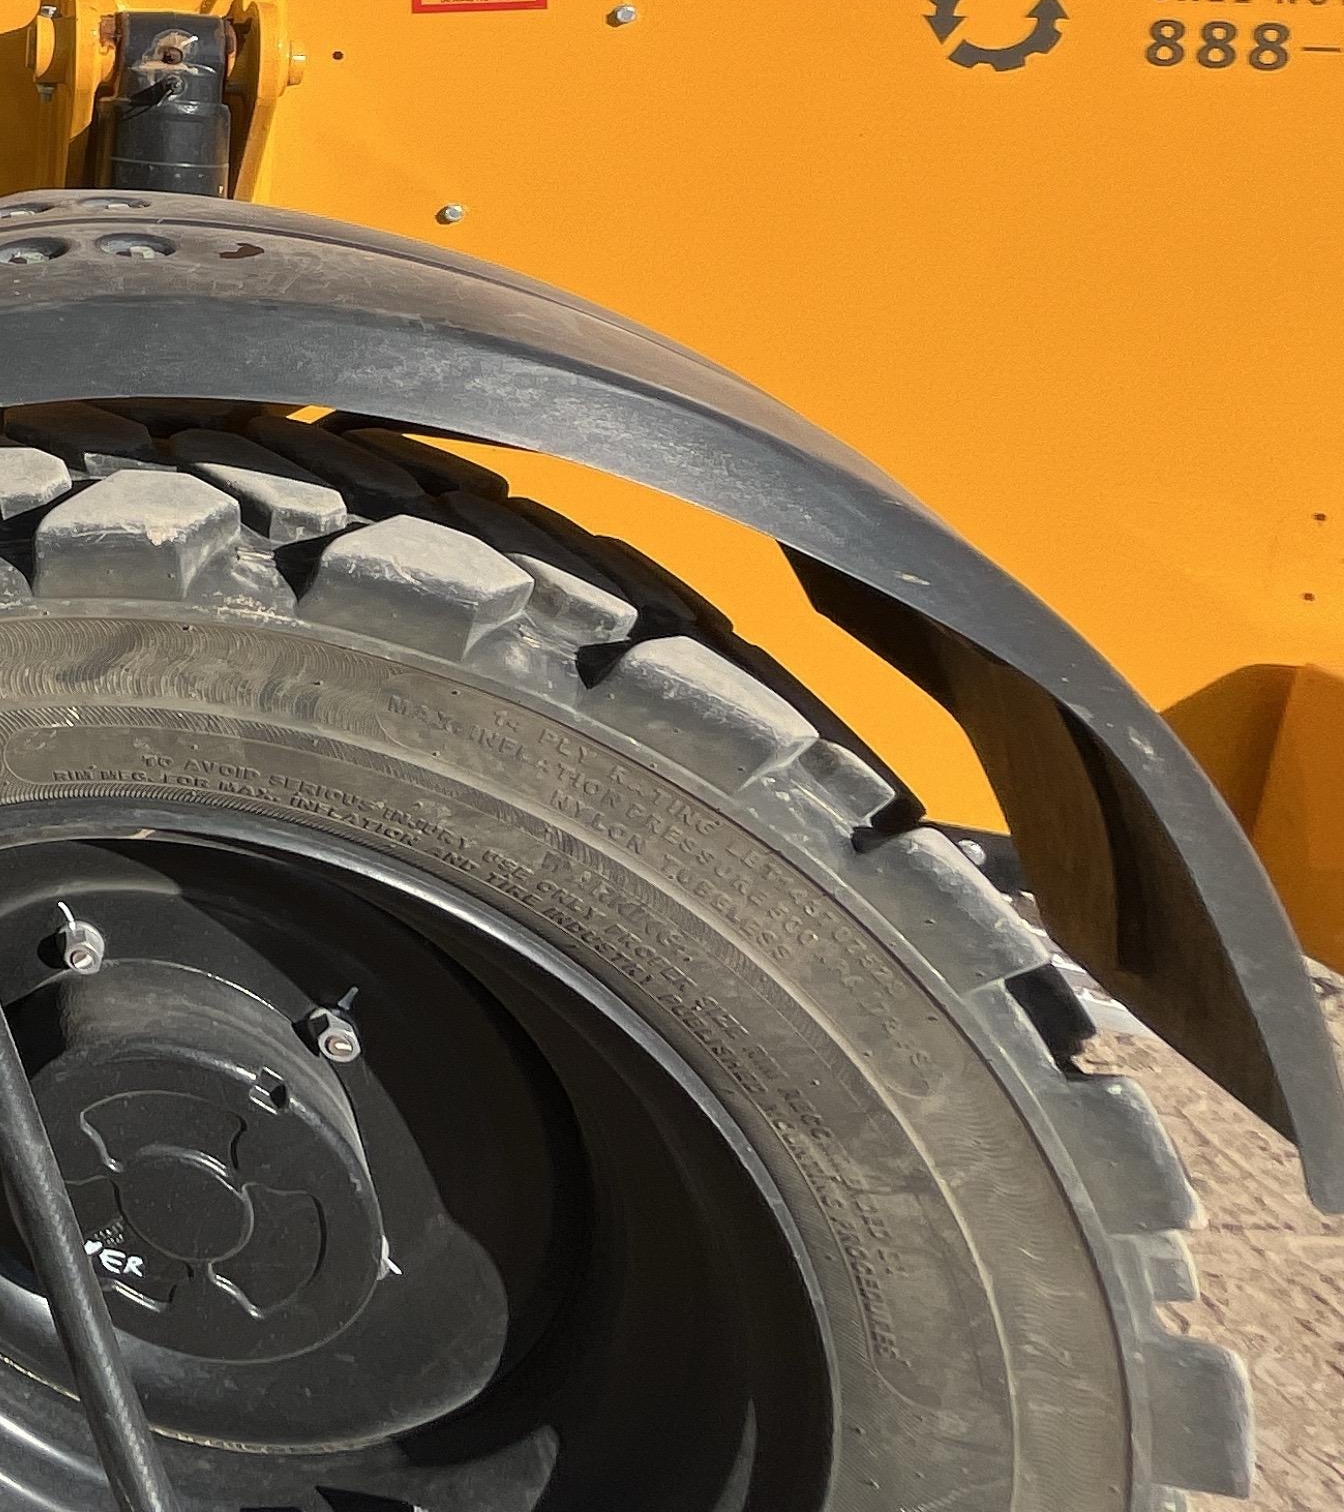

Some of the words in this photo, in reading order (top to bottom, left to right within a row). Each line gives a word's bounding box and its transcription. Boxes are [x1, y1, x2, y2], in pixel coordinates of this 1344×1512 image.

[537, 727, 589, 764] PLY
[52, 769, 98, 784] RIM
[160, 773, 210, 789] FOR
[288, 795, 422, 847] INFLATION
[486, 870, 545, 907] TIRE
[139, 753, 174, 770] TO
[183, 757, 262, 782] AVOID
[267, 774, 381, 817] SERIOUS
[383, 804, 478, 851] INJURY
[481, 847, 535, 881] USE
[535, 880, 608, 920] ONLY
